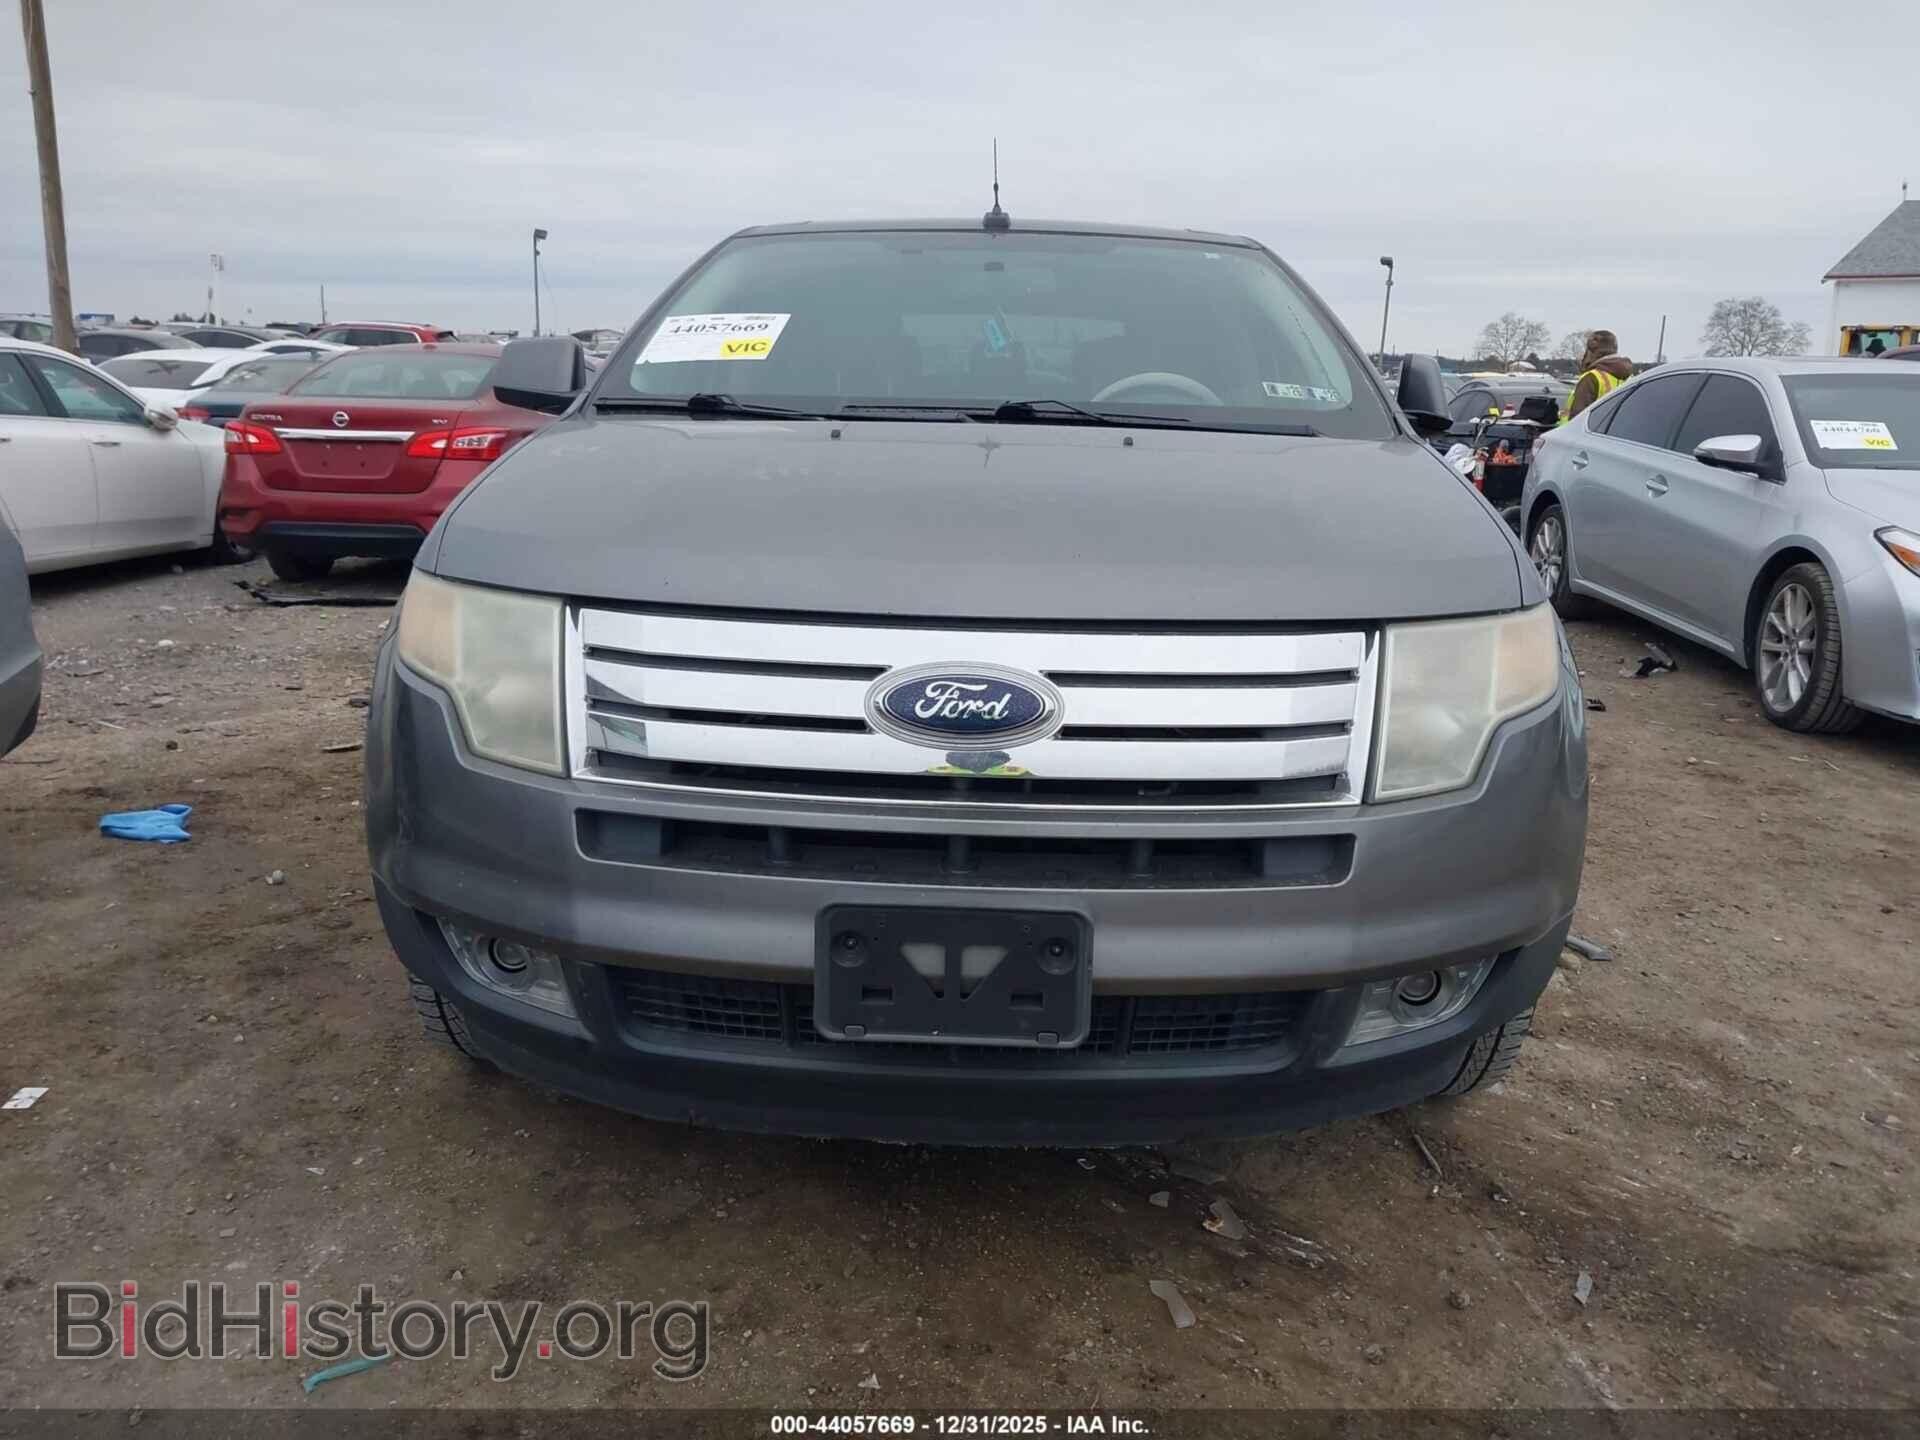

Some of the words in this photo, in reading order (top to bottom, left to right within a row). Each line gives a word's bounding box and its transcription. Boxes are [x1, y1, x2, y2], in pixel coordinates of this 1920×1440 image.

[669, 323, 770, 334] 44057669
[726, 341, 768, 353] VIC
[914, 680, 1012, 720] Ford
